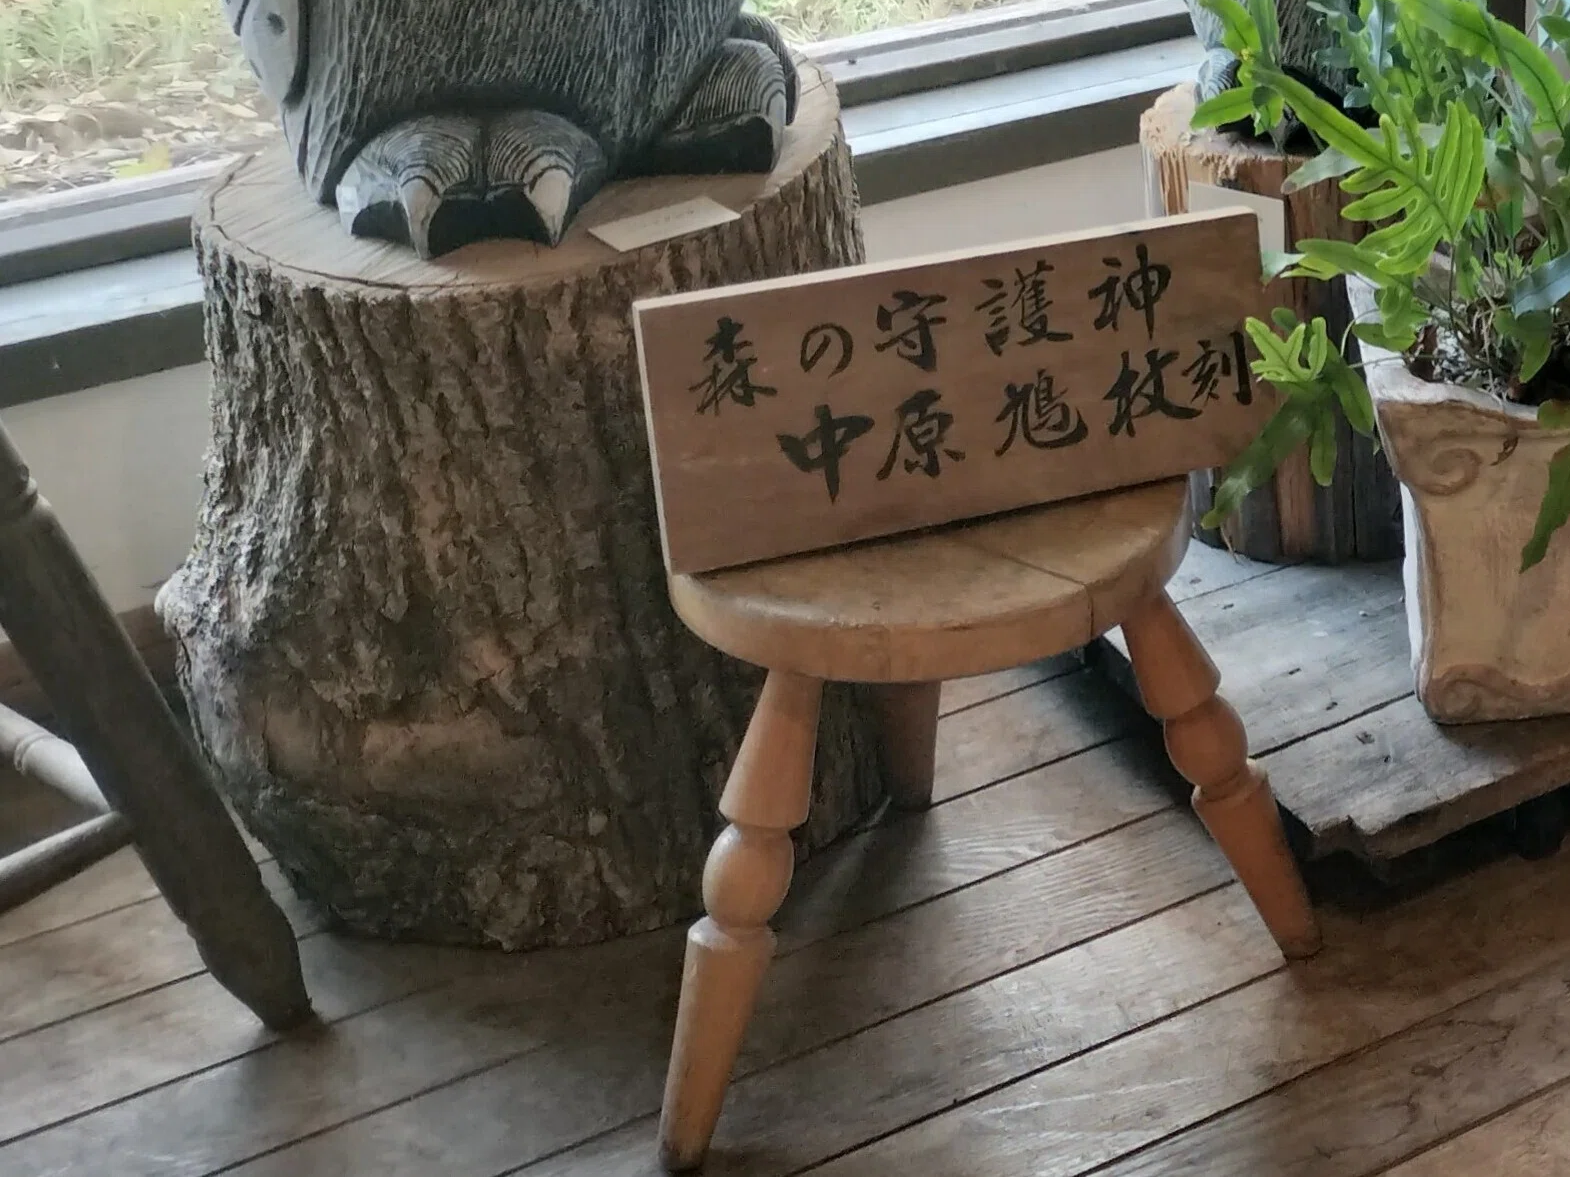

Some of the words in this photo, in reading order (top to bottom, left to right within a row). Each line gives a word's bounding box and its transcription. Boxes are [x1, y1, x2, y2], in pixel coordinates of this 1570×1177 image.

[689, 244, 1171, 416] 森の守護神
